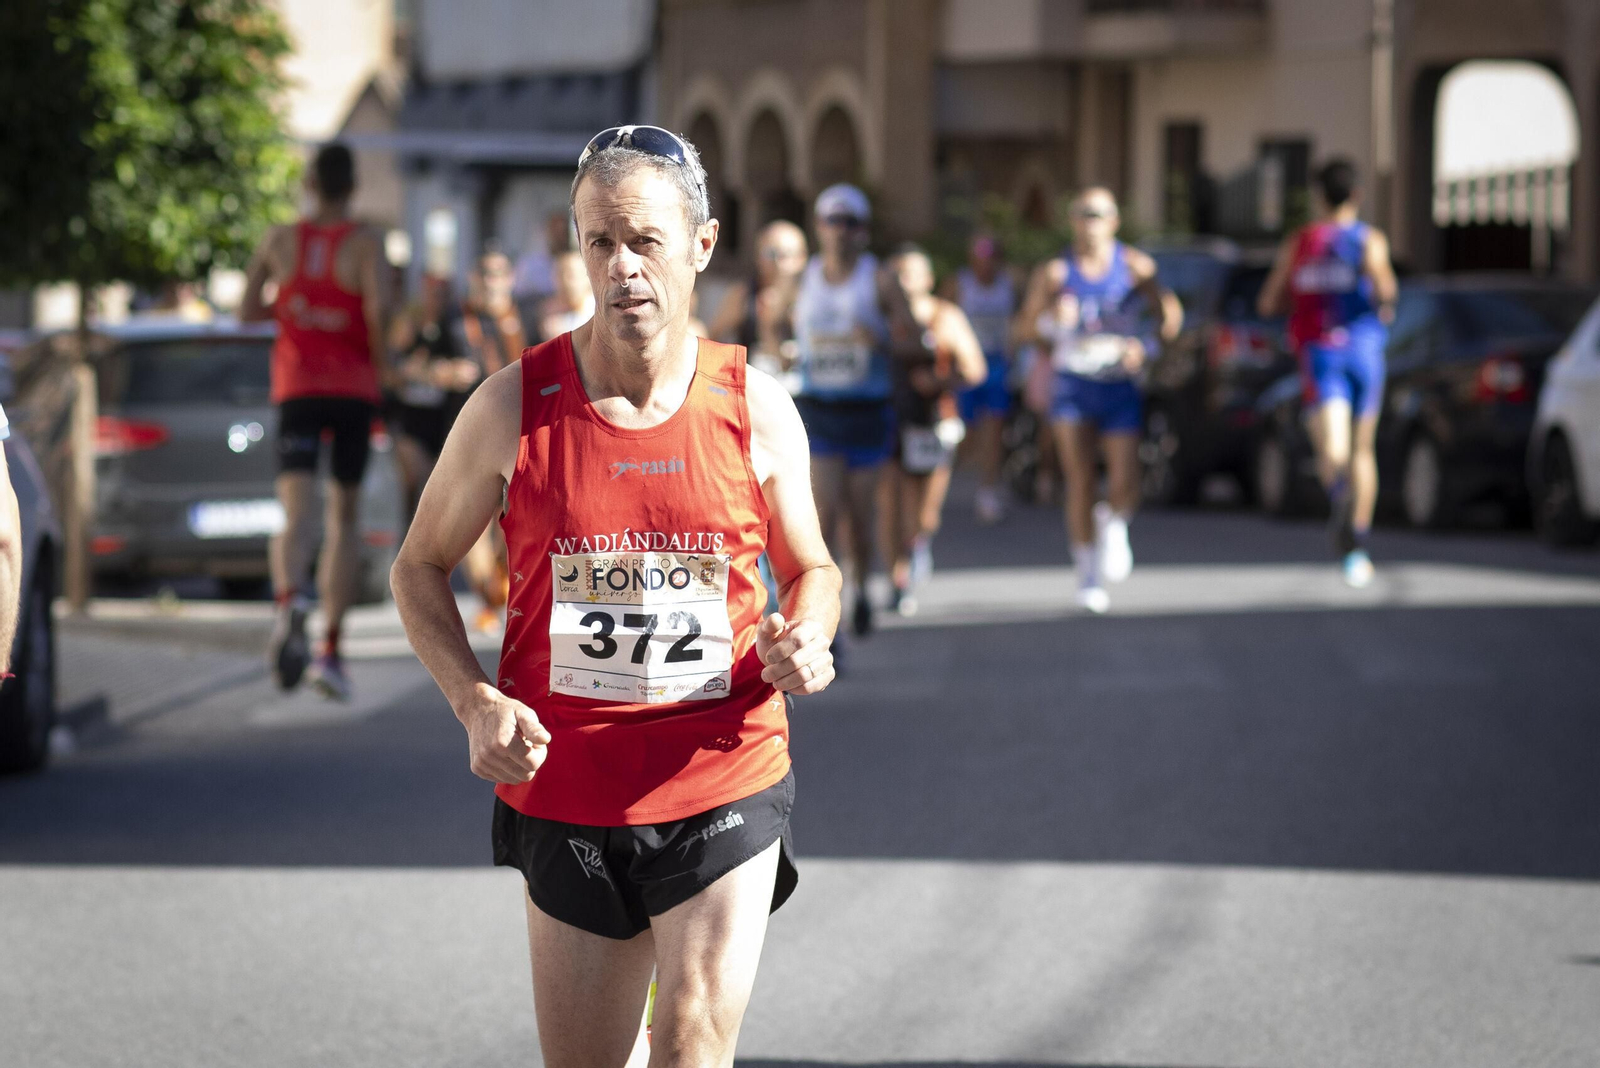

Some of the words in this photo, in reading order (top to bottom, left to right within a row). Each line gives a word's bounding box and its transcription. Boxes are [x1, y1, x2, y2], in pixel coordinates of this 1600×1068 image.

[641, 456, 685, 475] rasán
[554, 528, 725, 555] WADIÁNDALUS
[591, 559, 629, 569] GRAN
[591, 567, 691, 591] FONDO
[578, 610, 703, 665] 372
[701, 811, 745, 840] rasán
